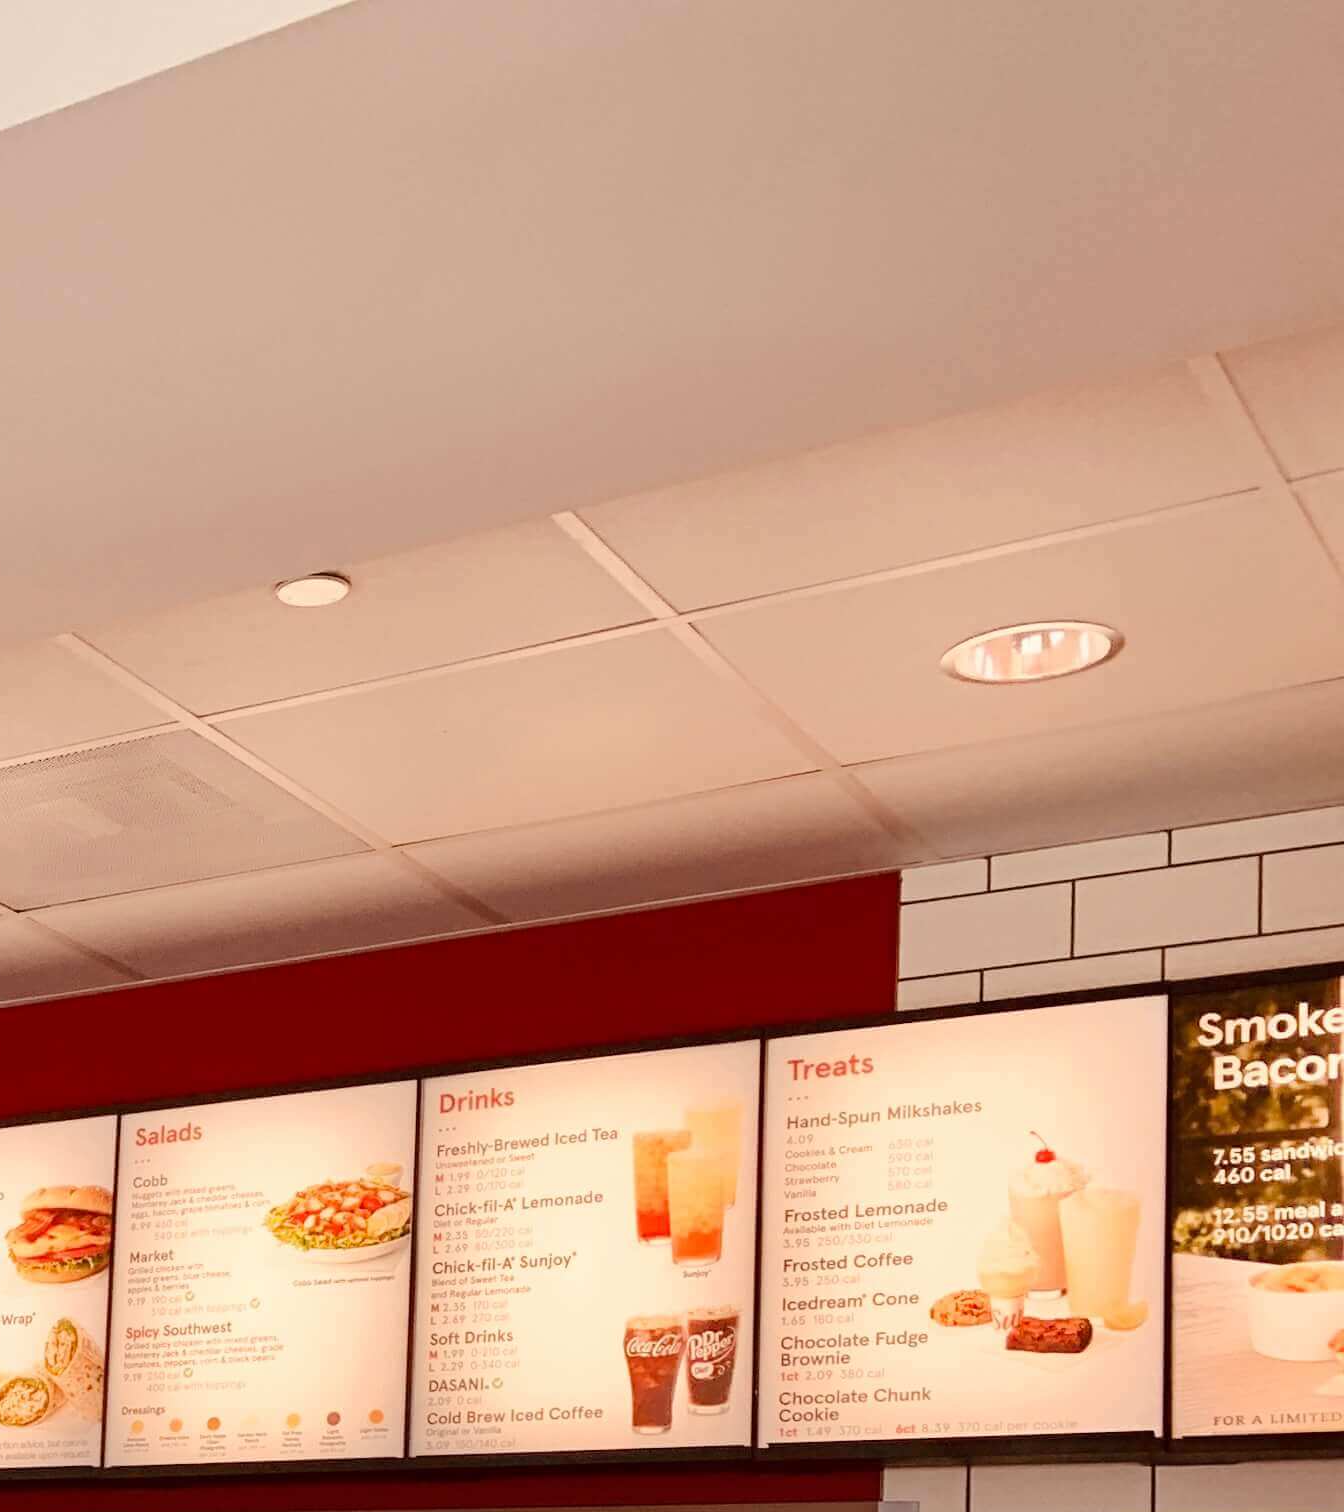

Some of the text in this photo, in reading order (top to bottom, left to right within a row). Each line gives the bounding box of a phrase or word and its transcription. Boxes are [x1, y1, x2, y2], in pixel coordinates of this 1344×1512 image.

[787, 1054, 874, 1081] Treats
[439, 1087, 515, 1114] Drinks
[786, 1099, 983, 1130] Hand-Spun Milkshakes
[136, 1122, 203, 1147] Salads
[437, 1127, 618, 1158] Freshly-Brewed Iced Tea
[786, 1134, 814, 1146] 4.09
[509, 1153, 535, 1163] Sweet
[785, 1143, 873, 1160] Cookies & Cream
[1213, 1147, 1256, 1165] 7.55
[784, 1159, 837, 1172] Chocolate
[133, 1175, 168, 1189] Cobb
[435, 1174, 445, 1183] M
[784, 1173, 840, 1187] Strawberry
[1214, 1164, 1291, 1185] 460 cal
[435, 1185, 441, 1195] L
[784, 1189, 817, 1199] Vanilla
[522, 1190, 604, 1211] Lemonade
[784, 1199, 948, 1224] Frosted Lemonade
[1213, 1206, 1269, 1226] 12.55
[1274, 1204, 1325, 1222] meal
[466, 1215, 498, 1227] Regular
[783, 1216, 934, 1235] Available with Diet Lemonade
[433, 1231, 442, 1242] M
[1213, 1222, 1314, 1244] 910/1020
[433, 1244, 439, 1254] L
[783, 1236, 810, 1249] 3.95
[130, 1250, 174, 1264] Market
[783, 1252, 913, 1273] Frosted Coffee
[471, 1275, 497, 1285] Sweet
[485, 1285, 531, 1297] Lemonade
[872, 1291, 919, 1306] Cone
[126, 1322, 232, 1340] Spicy Southwest
[430, 1328, 513, 1346] Soft Drinks
[780, 1331, 928, 1350] Chocolate Fudge
[780, 1351, 851, 1368] Brownie
[780, 1369, 832, 1381] 1ct 2.09
[779, 1387, 931, 1406] Chocolate Chunk
[122, 1405, 165, 1416] Dressings
[427, 1405, 604, 1426] Cold Brew Iced Coffee
[779, 1408, 839, 1424] Cookie
[1214, 1410, 1343, 1426] FOR A LIMITED
[779, 1426, 798, 1438] 1ct
[896, 1423, 916, 1434] 6ct
